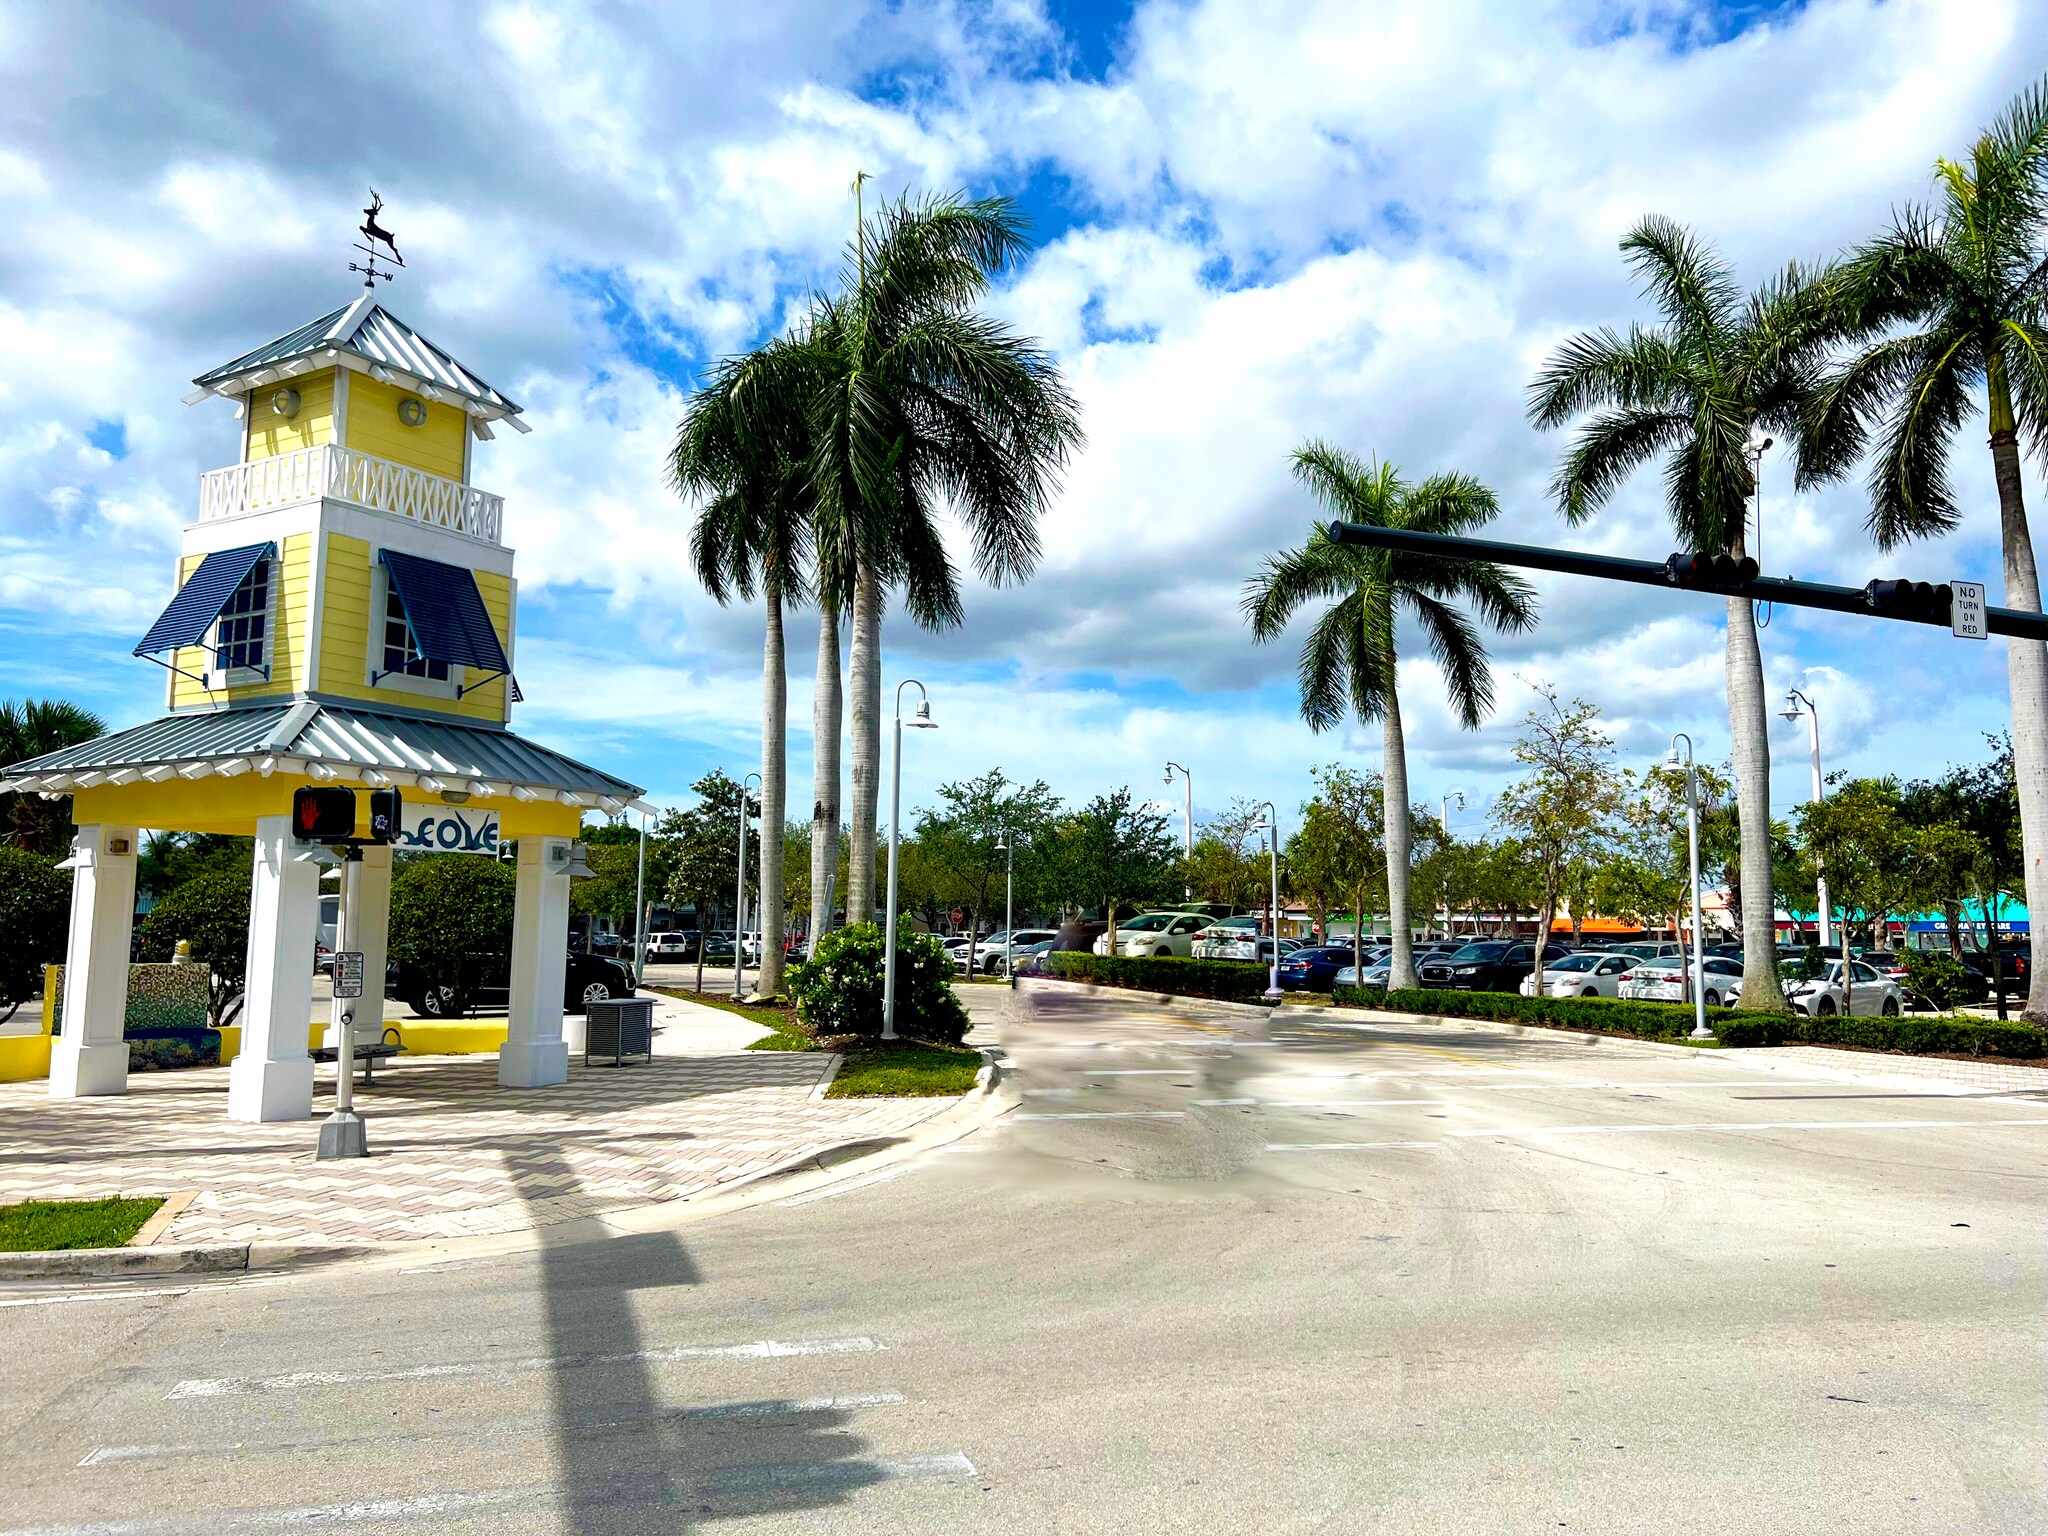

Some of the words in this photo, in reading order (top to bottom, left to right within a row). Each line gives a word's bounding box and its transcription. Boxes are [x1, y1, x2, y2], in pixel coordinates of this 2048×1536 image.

[385, 272, 393, 281] W
[1959, 587, 1975, 598] NO
[1959, 600, 1978, 610] TURN
[1963, 612, 1975, 621] ON
[1962, 625, 1977, 634] RED
